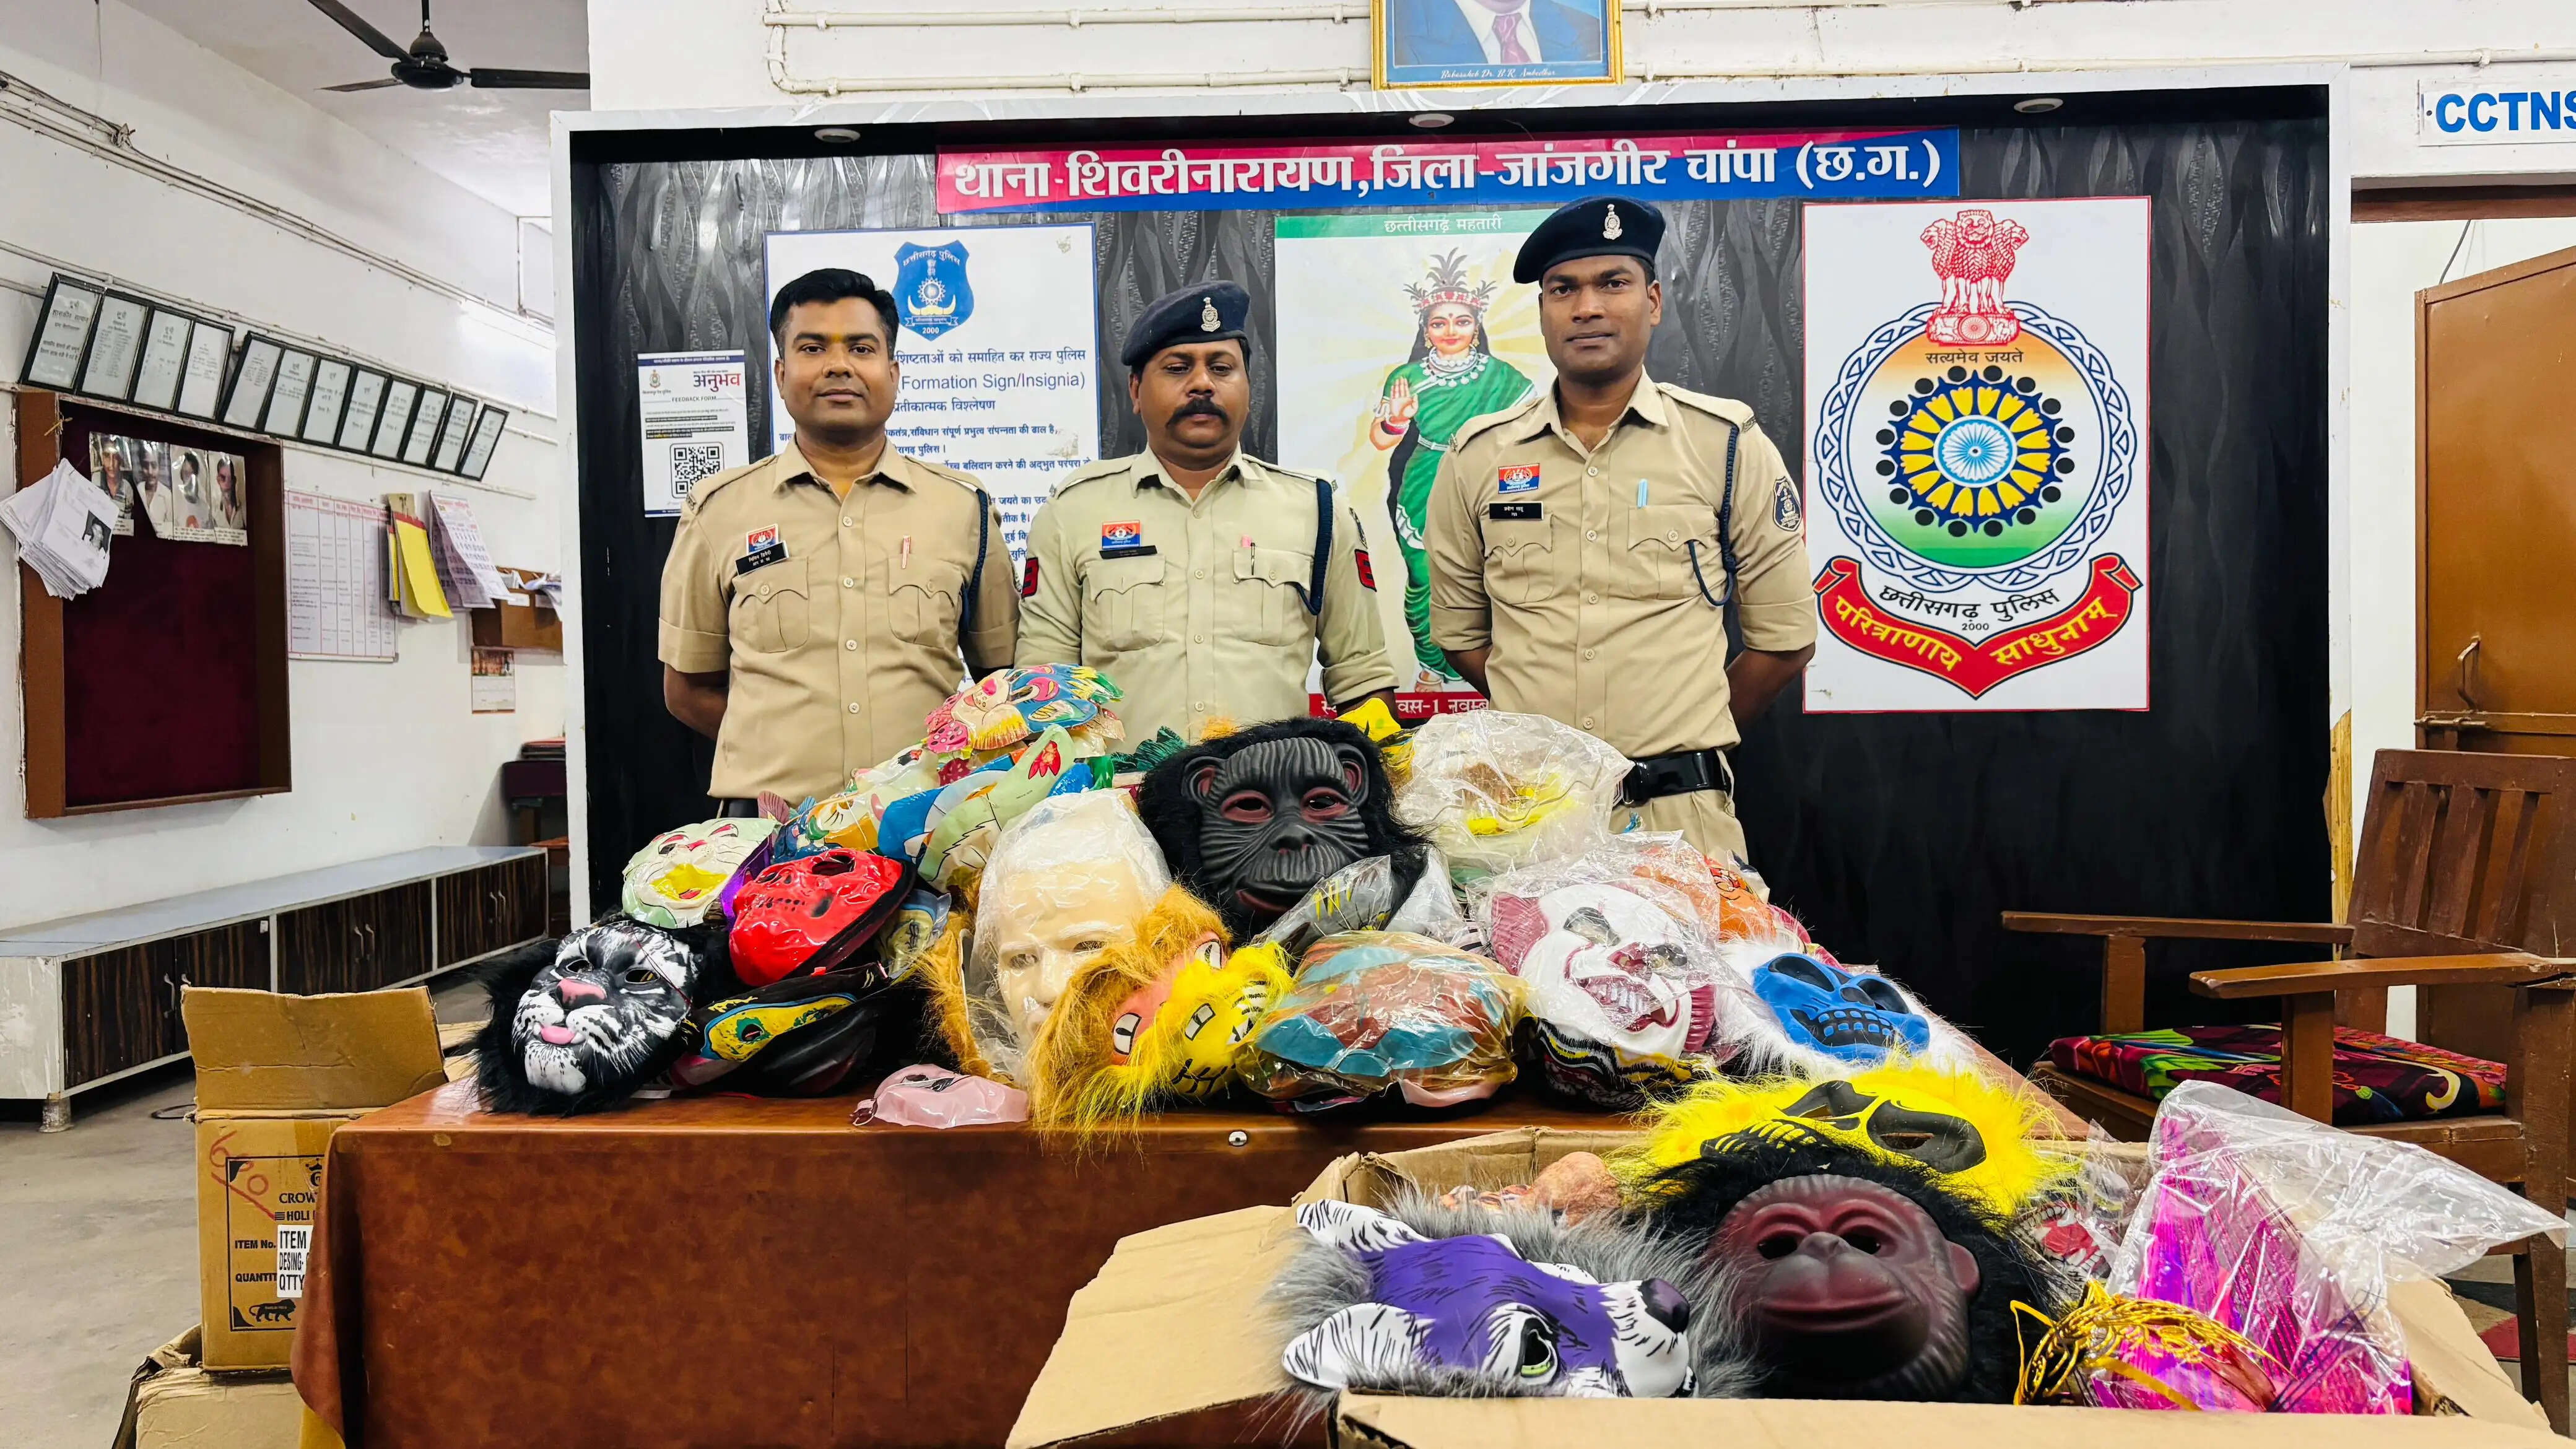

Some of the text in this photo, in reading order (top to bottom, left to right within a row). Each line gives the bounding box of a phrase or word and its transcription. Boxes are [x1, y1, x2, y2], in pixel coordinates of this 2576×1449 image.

[1684, 140, 1777, 184] चांपा
[1795, 139, 1941, 189] (छ.ग.)
[1383, 214, 1503, 234] छत्तीसगढ़ महतारी
[894, 346, 1086, 365] शिष्टताओं को समाहित कर राज्य पुलिस
[1925, 347, 2024, 364] सत्यमेव जयते
[693, 373, 741, 392] अनुभव
[982, 372, 1085, 392] Sign/Insignia)
[951, 397, 996, 411] विश्लेषण
[1019, 424, 1029, 434] की
[918, 443, 940, 456] पुलिस
[962, 459, 993, 469] बलिदान
[994, 458, 1014, 469] करने
[1016, 458, 1026, 469] की
[998, 494, 1019, 505] जयते
[1020, 497, 1031, 505] का
[1002, 512, 1018, 523] तीक
[1879, 585, 2061, 621] छत्तीसगढ़ पुलिस
[1837, 595, 1962, 672] परित्राणाय
[1961, 622, 1990, 631] 2000
[1395, 698, 1489, 714] वस-1 नवम्ब
[279, 1191, 318, 1204] CROW
[287, 1210, 310, 1221] HOLI
[235, 1240, 276, 1249] ITEM No.
[280, 1230, 307, 1249] ITEM
[235, 1272, 277, 1282] QUANTIT
[279, 1273, 305, 1290] QTTY
